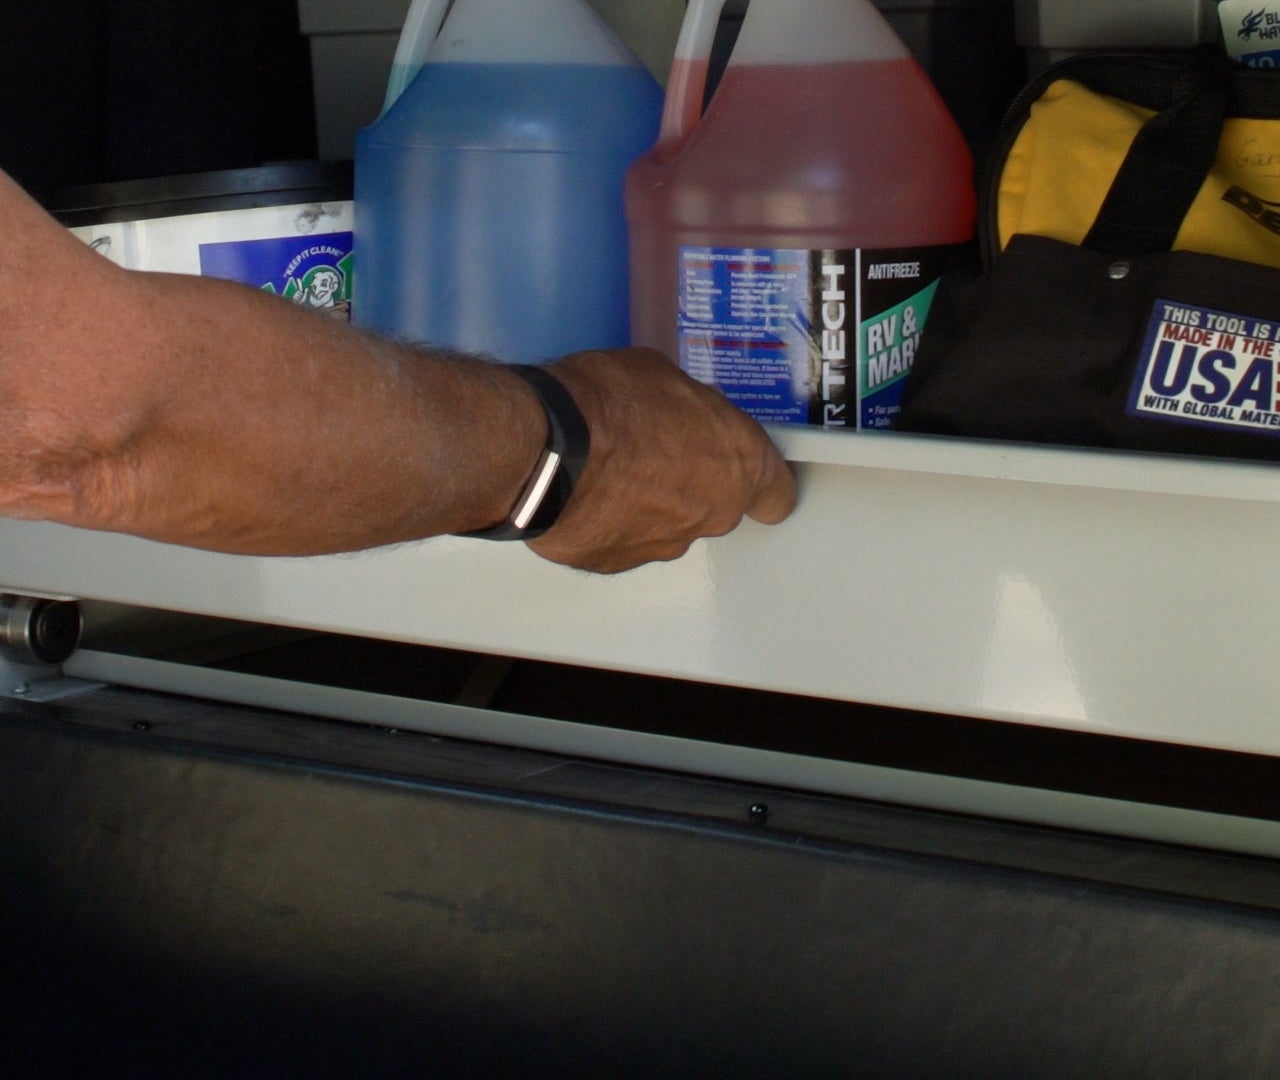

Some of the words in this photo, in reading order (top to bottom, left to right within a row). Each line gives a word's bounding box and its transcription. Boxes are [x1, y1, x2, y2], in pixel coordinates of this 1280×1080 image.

[867, 262, 920, 280] ANTIFREEZE
[868, 315, 897, 356] RV
[902, 305, 917, 337] &
[1163, 305, 1201, 326] THIS
[1206, 314, 1247, 335] TOOL
[1253, 322, 1271, 339] IS
[822, 264, 845, 427] RTECH
[1162, 323, 1213, 347] MADE
[1219, 334, 1234, 351] IN
[1242, 338, 1275, 358] THE
[1149, 340, 1275, 412] USA
[1143, 395, 1178, 411] WITH
[1183, 401, 1234, 420] GLOBAL
